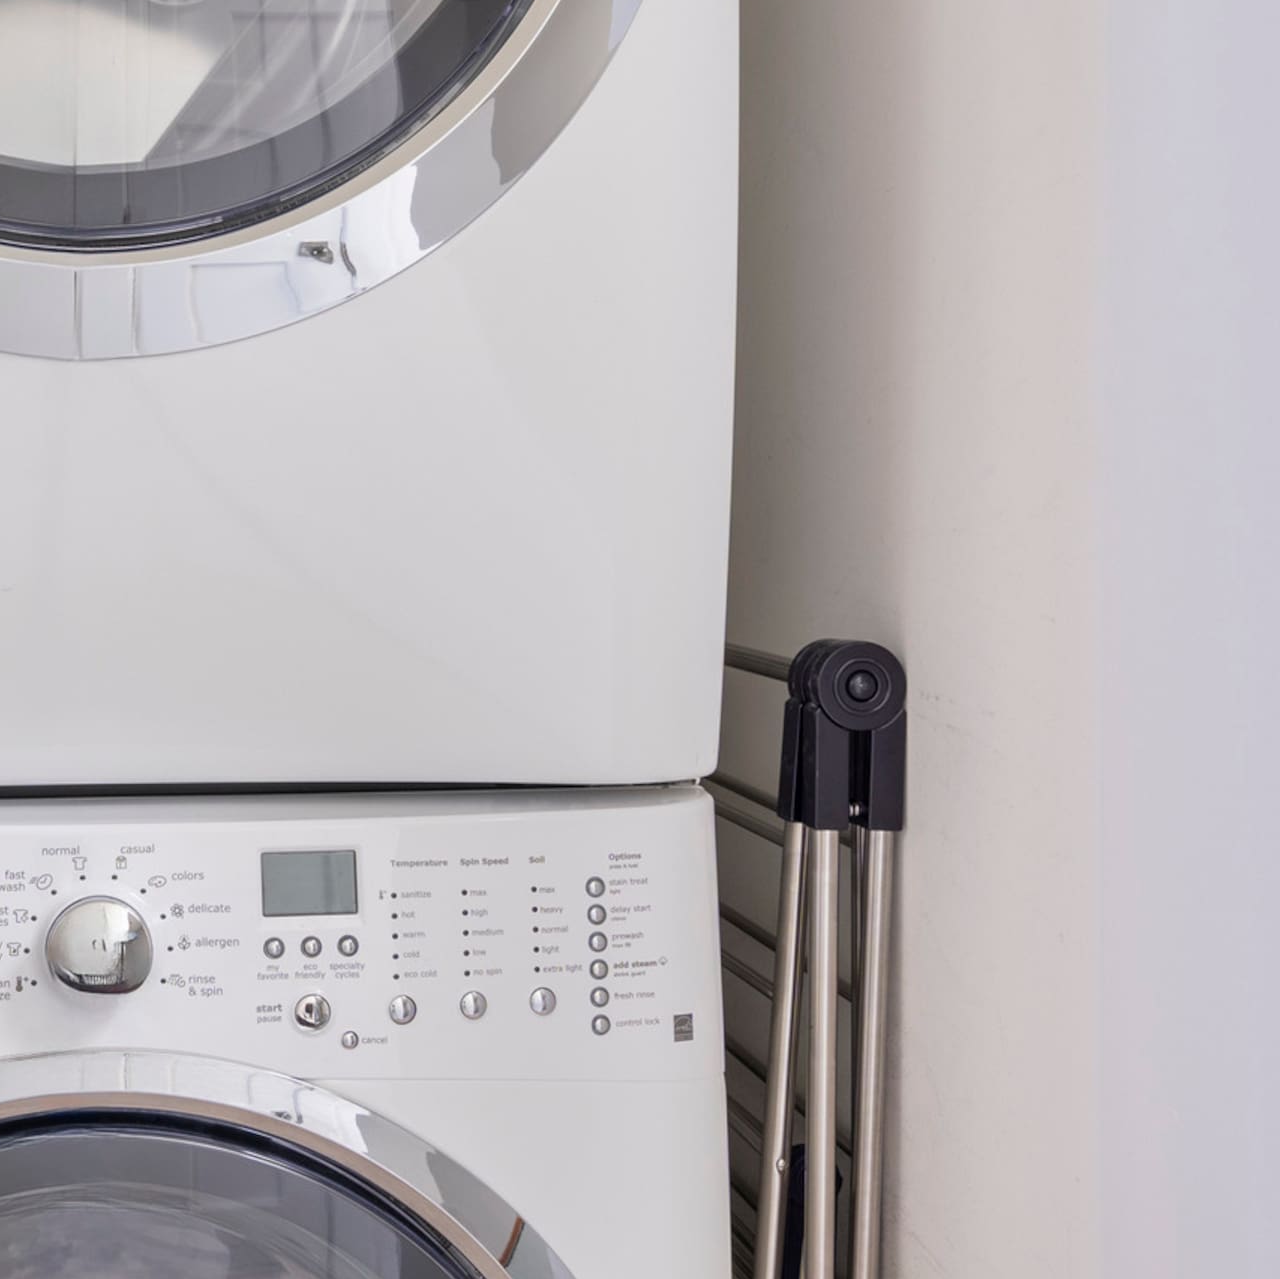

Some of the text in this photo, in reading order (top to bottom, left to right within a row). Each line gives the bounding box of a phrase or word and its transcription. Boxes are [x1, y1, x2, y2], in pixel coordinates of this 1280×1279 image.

[41, 845, 80, 856] normal
[120, 844, 155, 854] casual
[528, 856, 546, 864] Soil
[608, 852, 642, 862] Options
[390, 860, 448, 868] Temperature
[460, 857, 509, 867] Spin Speed
[4, 870, 26, 880] fast
[171, 871, 205, 881] colors
[401, 890, 432, 898] sanitize
[188, 903, 232, 914] delicate
[540, 906, 564, 914] heavy
[634, 904, 651, 912] start
[470, 908, 488, 918] high
[471, 928, 504, 936] medium
[541, 925, 568, 934] normal
[195, 937, 240, 948] allergen
[472, 948, 486, 956] low
[541, 946, 560, 954] light
[266, 964, 280, 972] my
[330, 962, 365, 970] specialty
[631, 960, 658, 968] steam
[486, 968, 502, 976] spin
[565, 964, 582, 973] light
[257, 972, 289, 980] favorite
[294, 972, 326, 980] friendly
[334, 970, 360, 980] cycles
[420, 970, 438, 978] cold
[188, 974, 216, 984] rinse
[188, 986, 224, 997] & spin
[256, 1004, 282, 1013] start
[256, 1016, 282, 1024] pause
[360, 1036, 388, 1044] cancel
